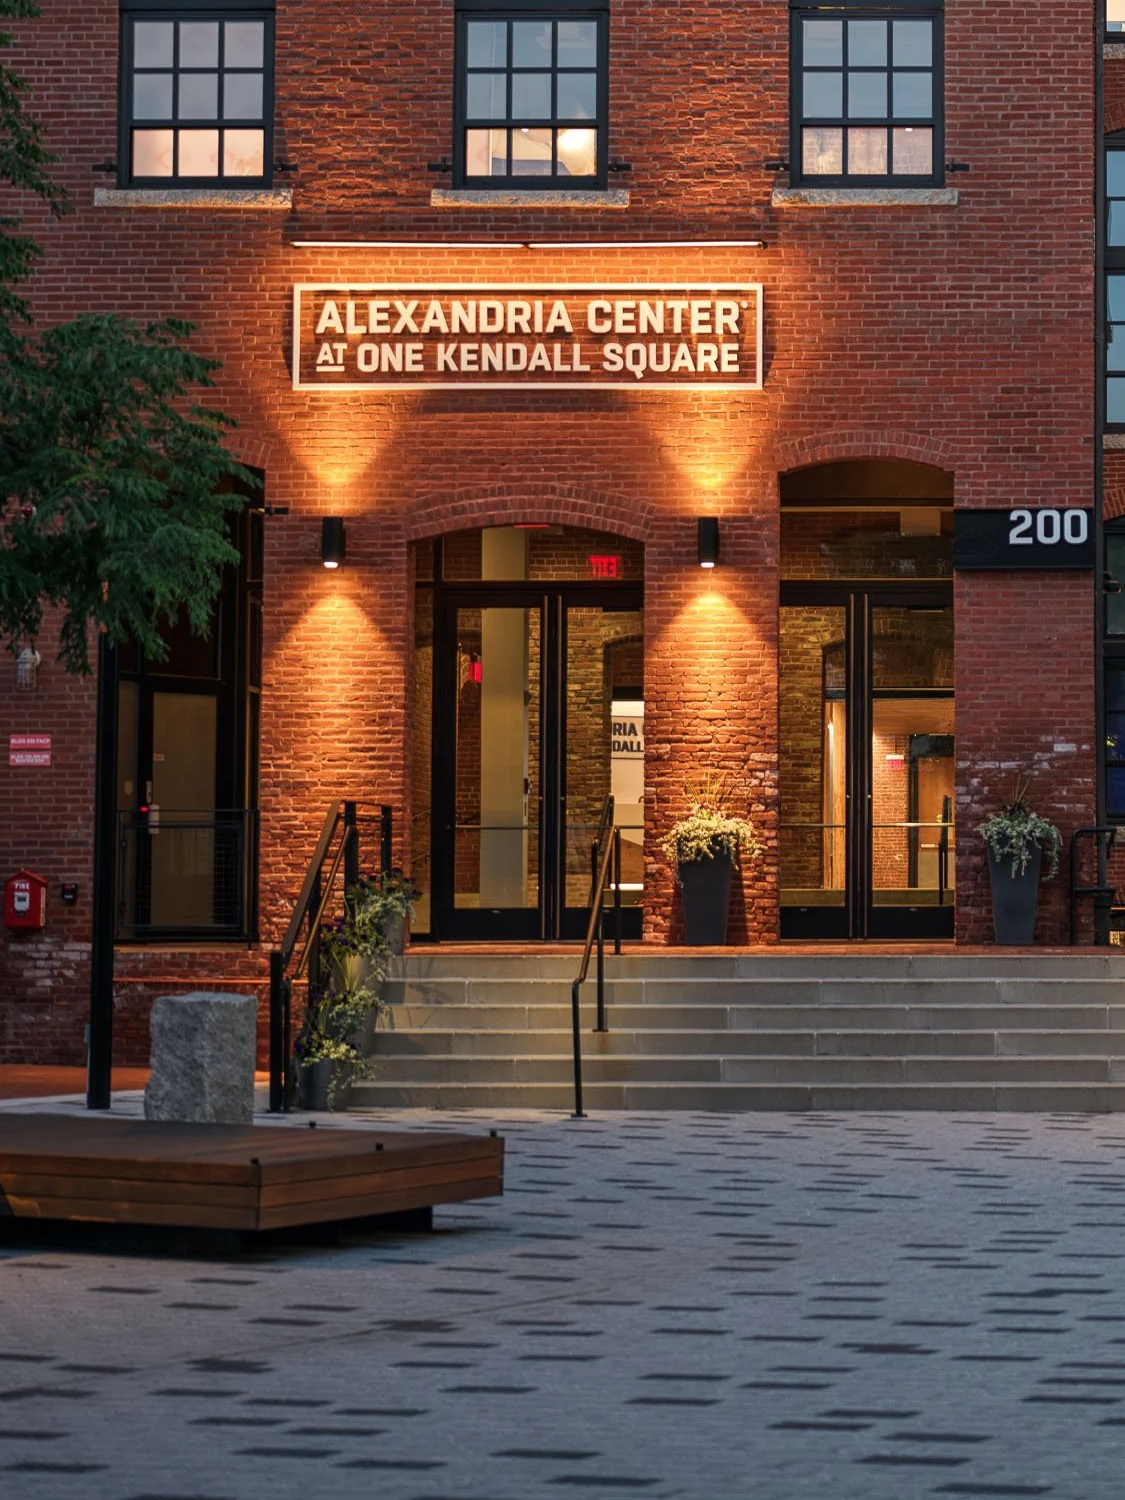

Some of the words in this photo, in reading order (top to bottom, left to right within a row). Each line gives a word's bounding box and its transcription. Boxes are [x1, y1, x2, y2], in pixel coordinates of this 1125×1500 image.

[315, 299, 574, 334] ALEXANDRIA
[587, 299, 740, 334] CENTER
[316, 342, 348, 367] AT
[357, 342, 424, 372] ONE
[437, 342, 591, 372] KENDALL
[602, 342, 740, 379] SQUARE
[1008, 509, 1088, 545] 200
[15, 882, 30, 890] FIRE
